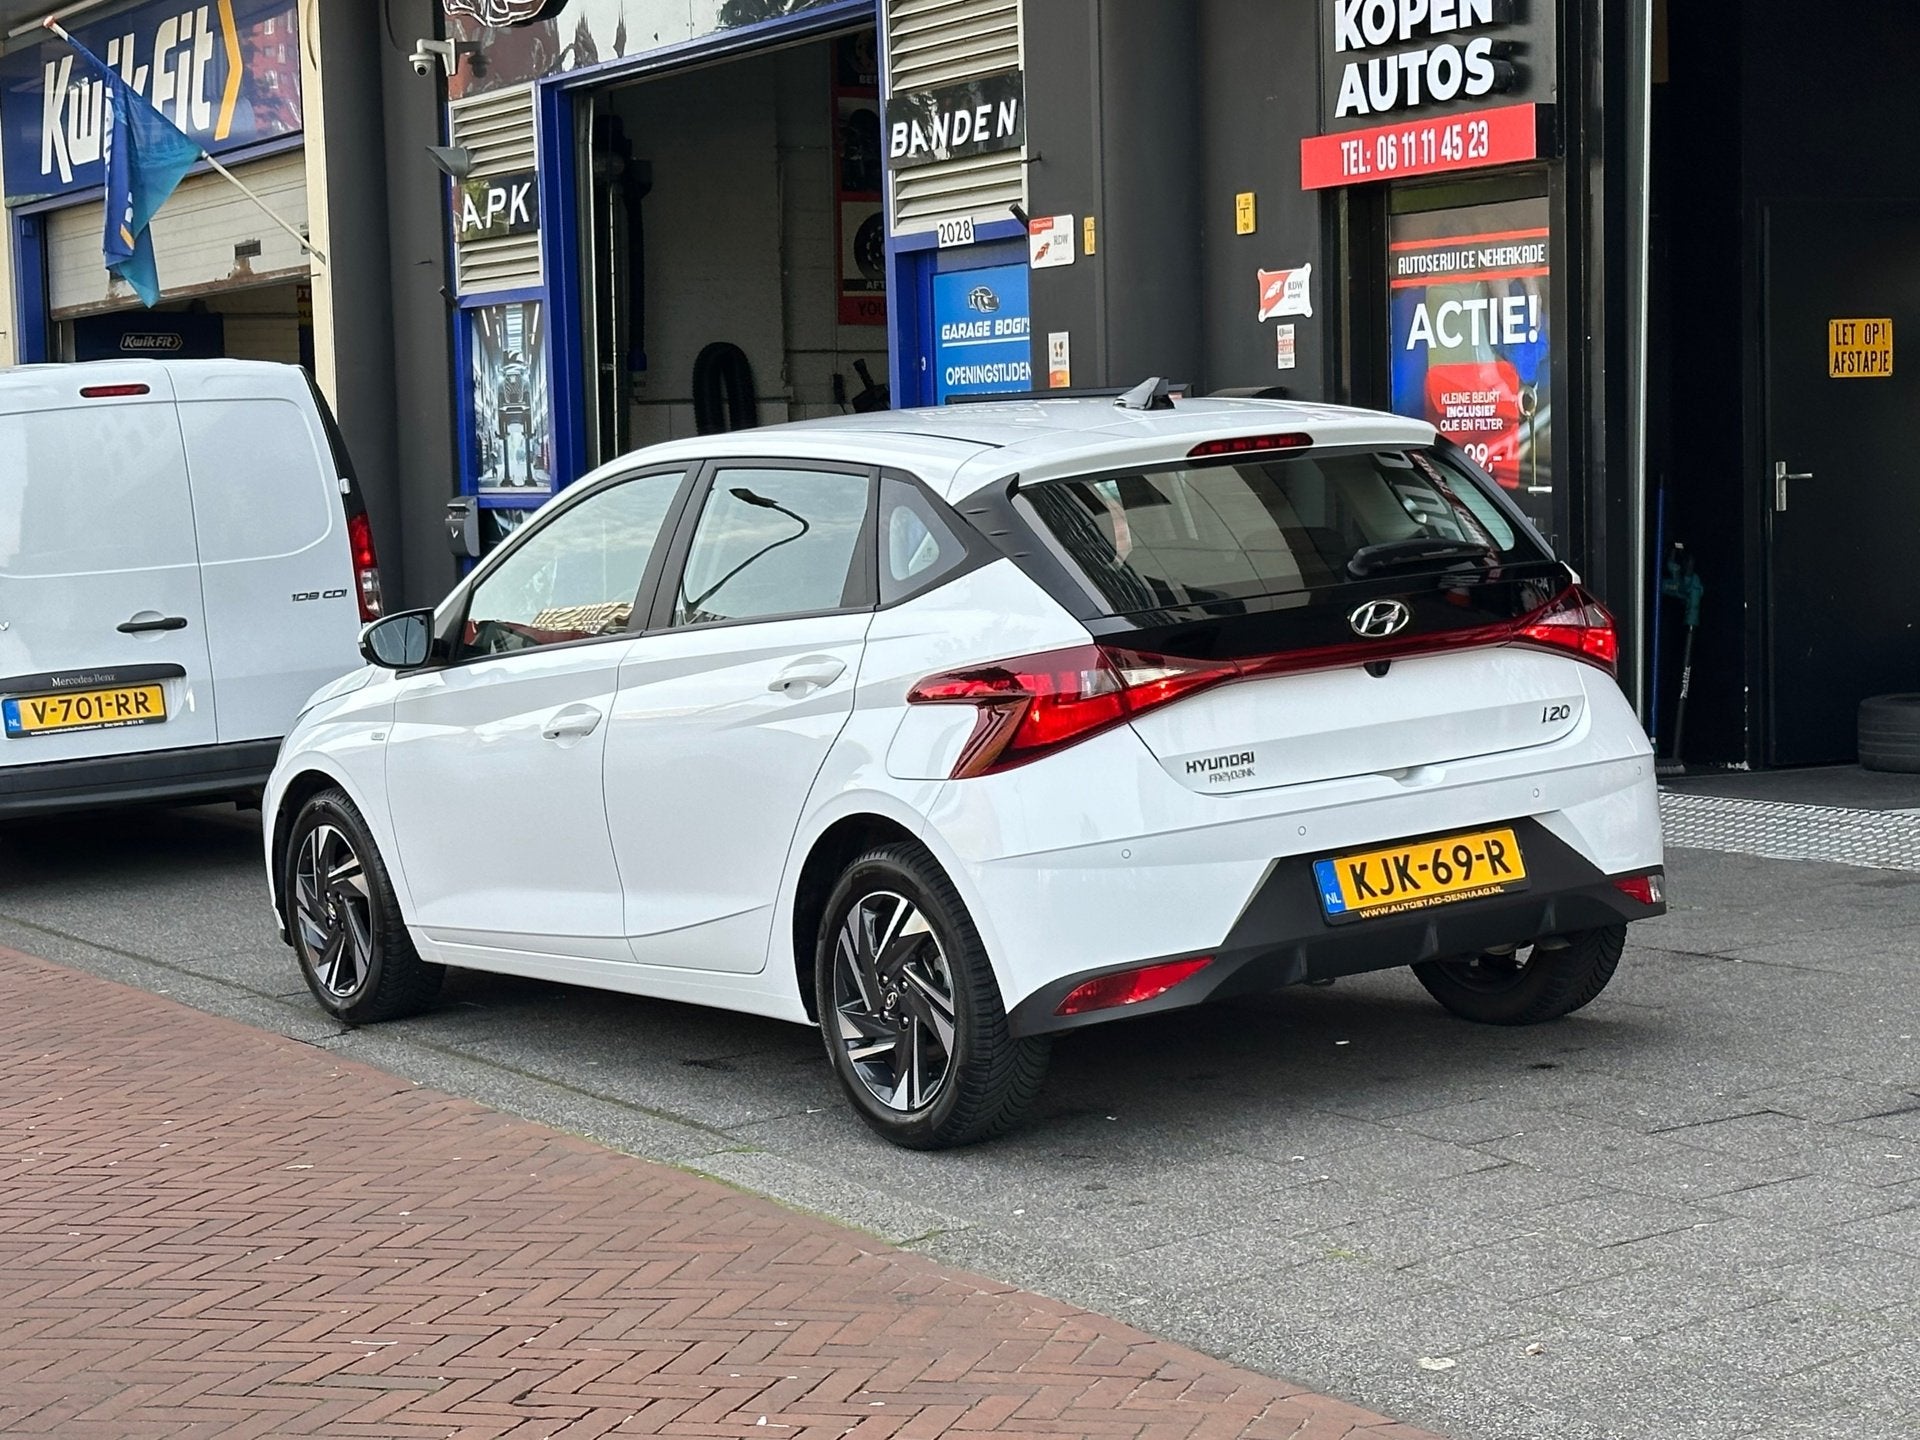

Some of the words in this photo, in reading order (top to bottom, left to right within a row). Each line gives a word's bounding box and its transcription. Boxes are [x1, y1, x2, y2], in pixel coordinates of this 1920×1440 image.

[1335, 0, 1493, 52] KOPEN
[1335, 37, 1495, 118] AUTOS
[890, 98, 1017, 158] BANDEN
[1340, 139, 1372, 176] TEL:
[1376, 134, 1398, 172] 06
[1401, 130, 1418, 168] 11
[1420, 128, 1436, 165] 11
[1440, 124, 1463, 161] 45
[1467, 120, 1489, 158] 23
[461, 182, 531, 232] APK
[938, 219, 972, 244] 2028
[1398, 250, 1476, 275] AUTOSERVICE
[1478, 243, 1546, 268] NEHERKADE
[942, 320, 992, 340] GARAGE
[1406, 294, 1539, 350] ACTIE!
[1835, 323, 1856, 346] LET
[1864, 323, 1886, 346] OP!
[945, 361, 1032, 386] OPENINGSTIJDEN
[1833, 350, 1890, 374] AFSTAPJE
[1441, 392, 1471, 405] KLEINE
[1472, 390, 1501, 403] BEURT
[1446, 404, 1497, 418] INCLUSIEF
[1461, 420, 1474, 431] EN
[1475, 418, 1503, 431] FILTER
[322, 588, 348, 600] CDI
[30, 690, 151, 725] V-701-RR
[8, 718, 20, 728] NL
[1186, 751, 1255, 774] HYUNDAI
[1348, 838, 1512, 900] KJK-69-R
[1326, 892, 1342, 904] NL
